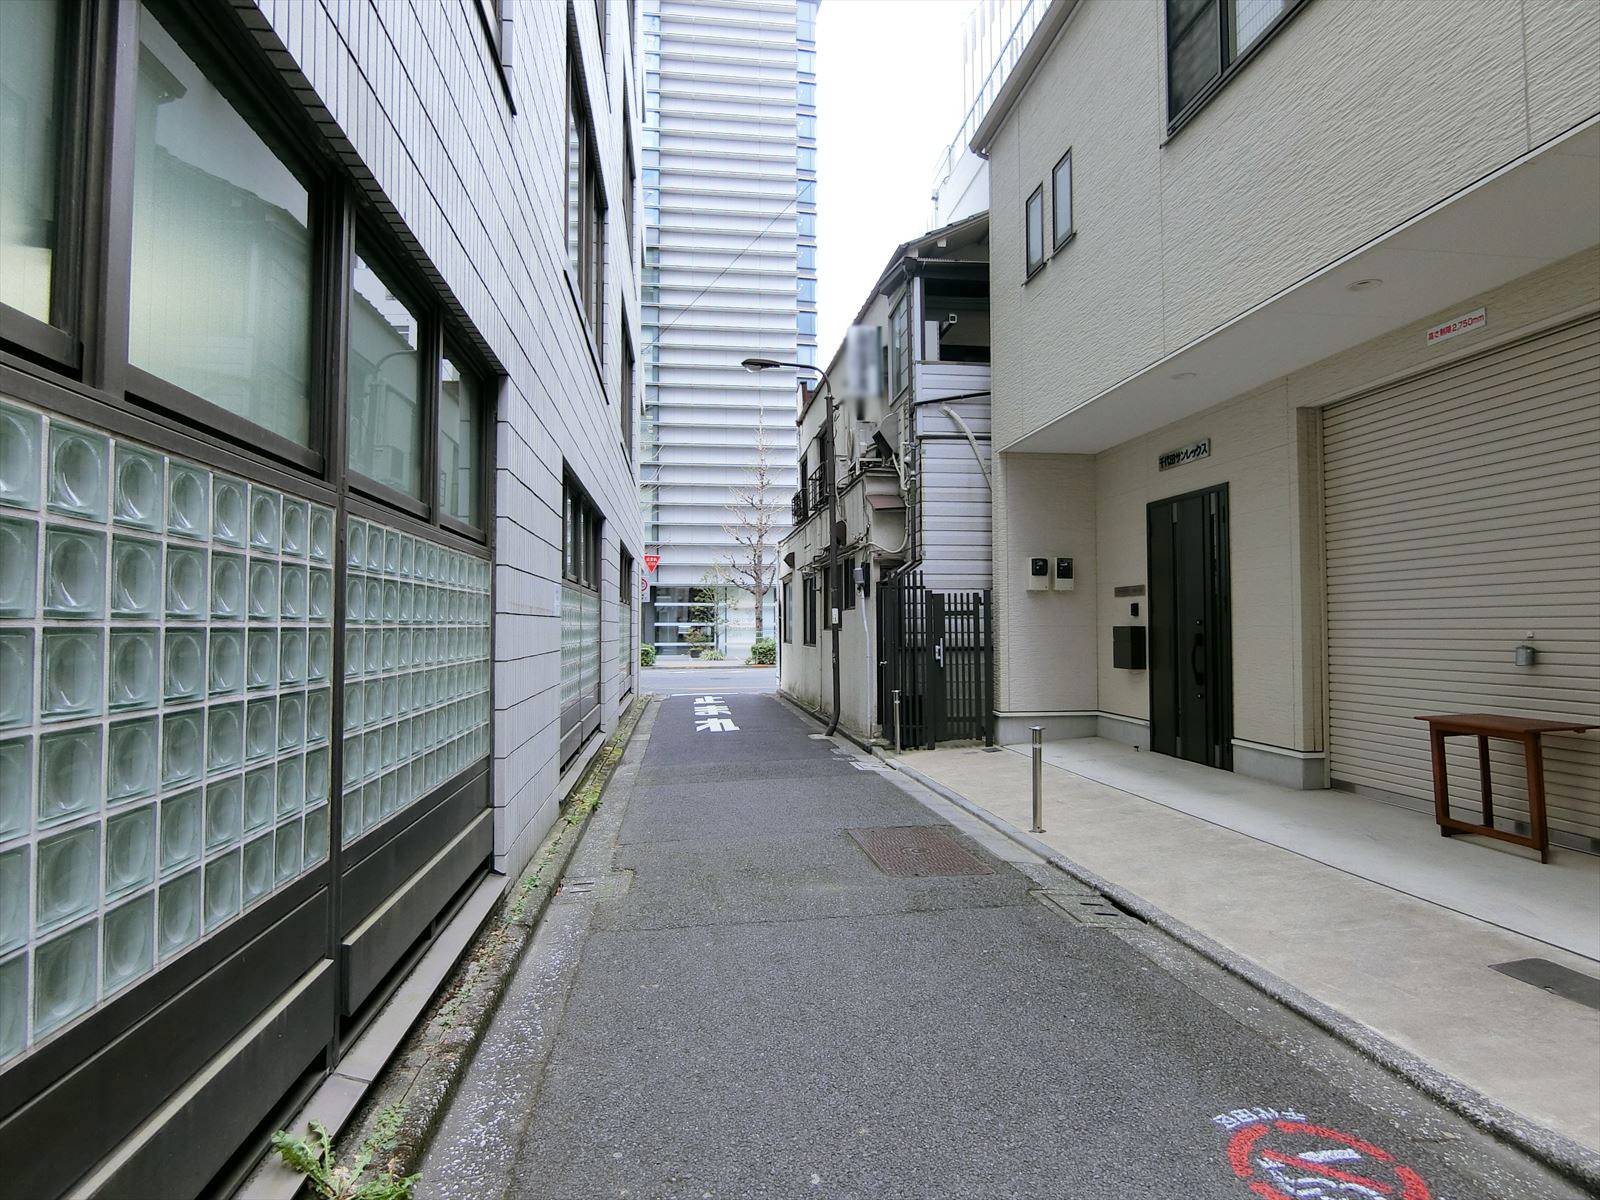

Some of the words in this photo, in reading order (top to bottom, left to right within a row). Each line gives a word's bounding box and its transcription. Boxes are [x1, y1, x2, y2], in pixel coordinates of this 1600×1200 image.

[1159, 443, 1208, 469] 千代田サンレックス
[693, 696, 741, 732] 止まれ
